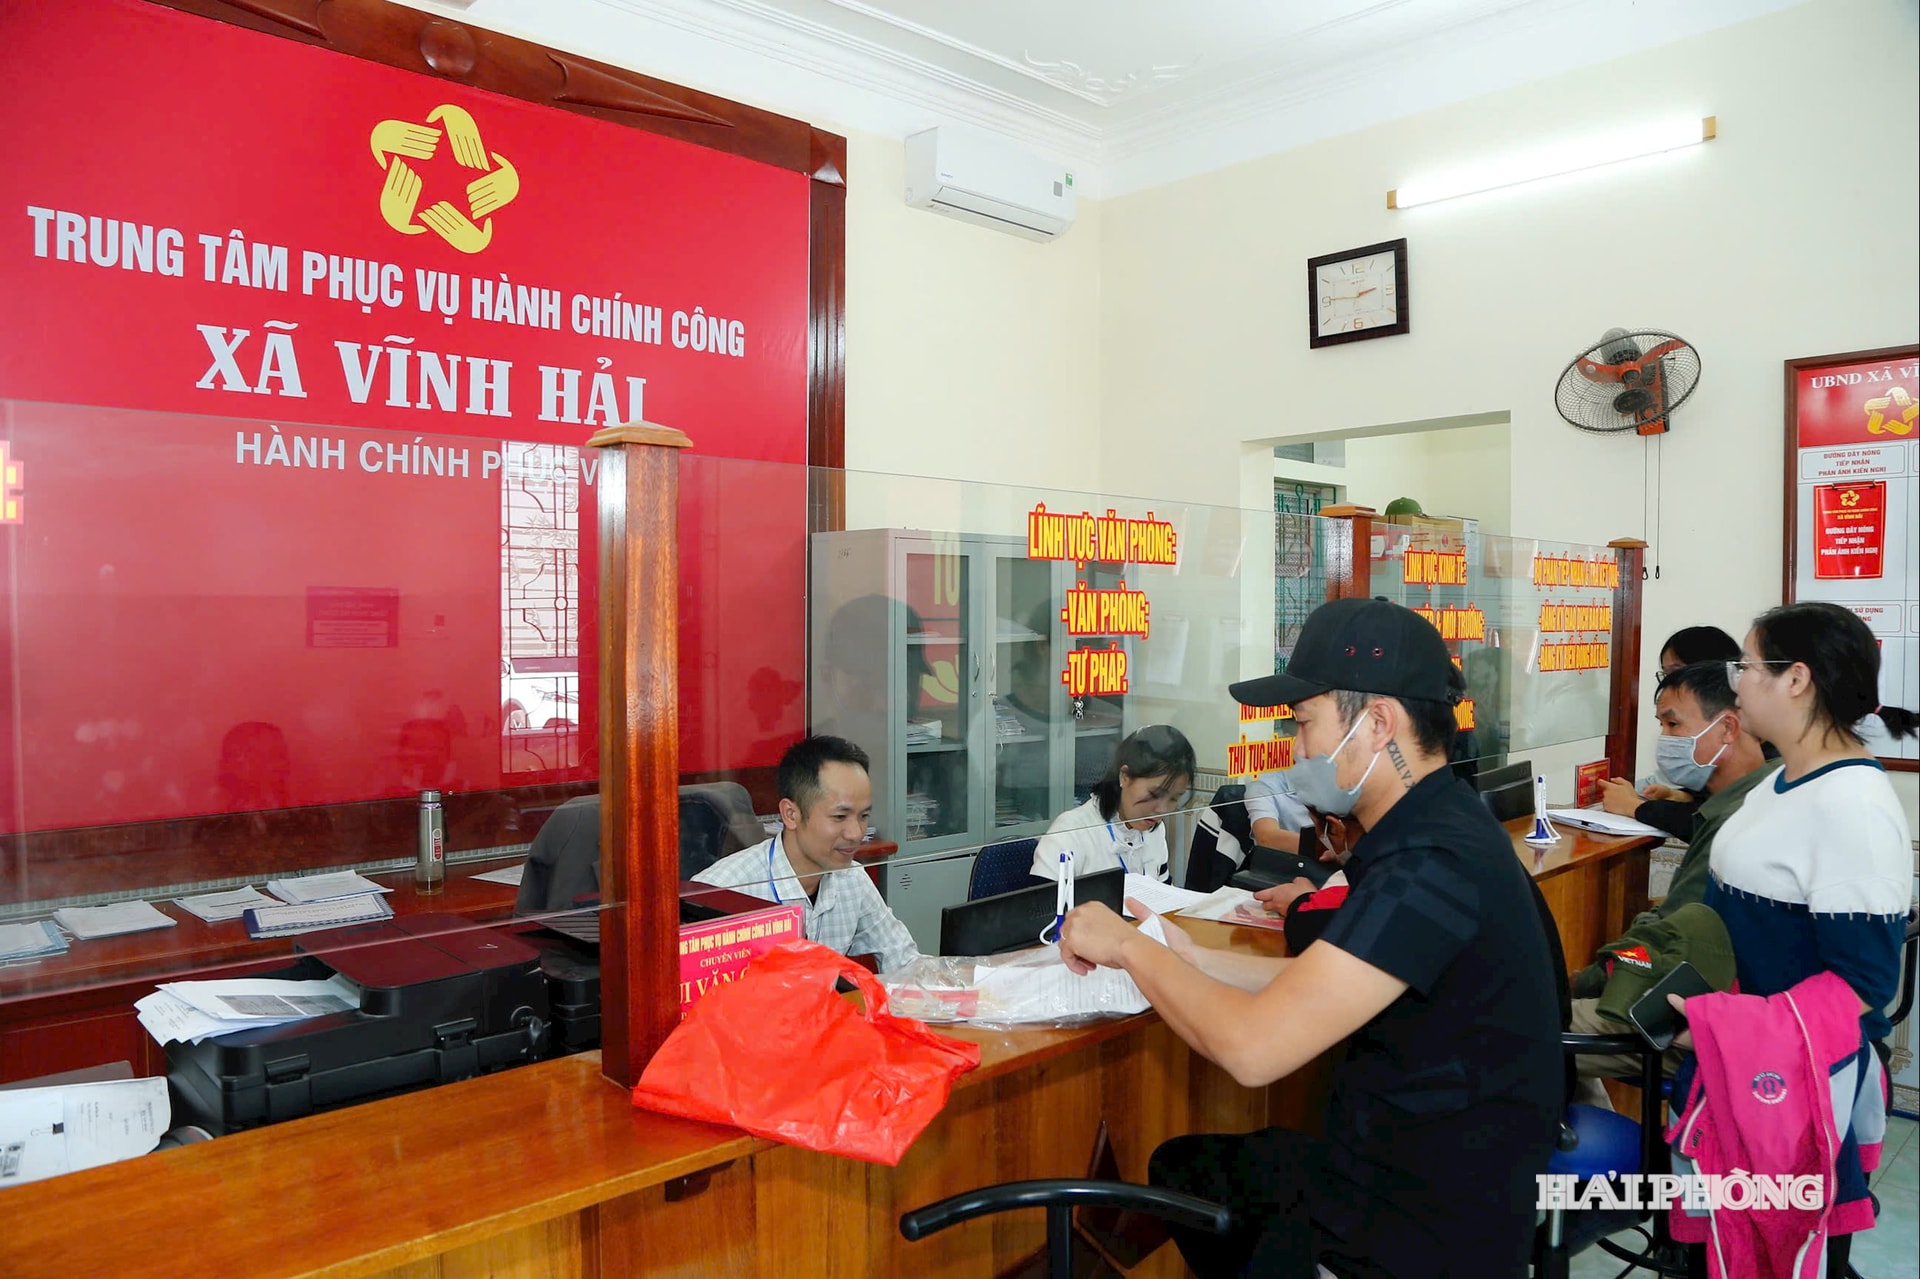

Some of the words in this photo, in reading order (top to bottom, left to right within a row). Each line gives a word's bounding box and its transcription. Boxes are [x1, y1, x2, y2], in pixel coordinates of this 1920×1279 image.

[27, 205, 184, 277] TRUNG
[198, 229, 288, 292] TÂM
[302, 250, 404, 314] PHỤC
[415, 268, 460, 325] VỤ
[471, 273, 561, 331] HÀNH
[571, 292, 662, 345] CHÍNH
[671, 306, 746, 358] CÔNG
[1351, 262, 1365, 275] 12
[1322, 296, 1331, 307] 9
[1353, 317, 1363, 329] 6
[195, 320, 307, 399] XÃ
[334, 334, 513, 418] VĨNH
[537, 356, 647, 428] HẢI
[1811, 373, 1862, 389] UBND
[1867, 366, 1893, 382] XÃ
[235, 425, 345, 471] HÀNH
[358, 436, 470, 478] CHÍNH
[1028, 502, 1065, 560] LĨNH
[1066, 512, 1096, 571] VỰC
[1097, 509, 1127, 562] VĂN
[1128, 512, 1176, 565] PHÒNG:
[1438, 552, 1456, 585] KINH
[1061, 580, 1099, 635] -VĂN
[1100, 580, 1150, 640] PHÒNG;
[1062, 646, 1088, 697] -TƯ
[1089, 641, 1129, 695] PHÁP.
[1228, 733, 1247, 776] THỦ
[1248, 742, 1265, 779] TỤC
[1266, 735, 1292, 770] HÀNH
[700, 952, 732, 968] CHUYÊN
[733, 948, 752, 962] VIÊN
[1617, 955, 1652, 969] VIETNAM
